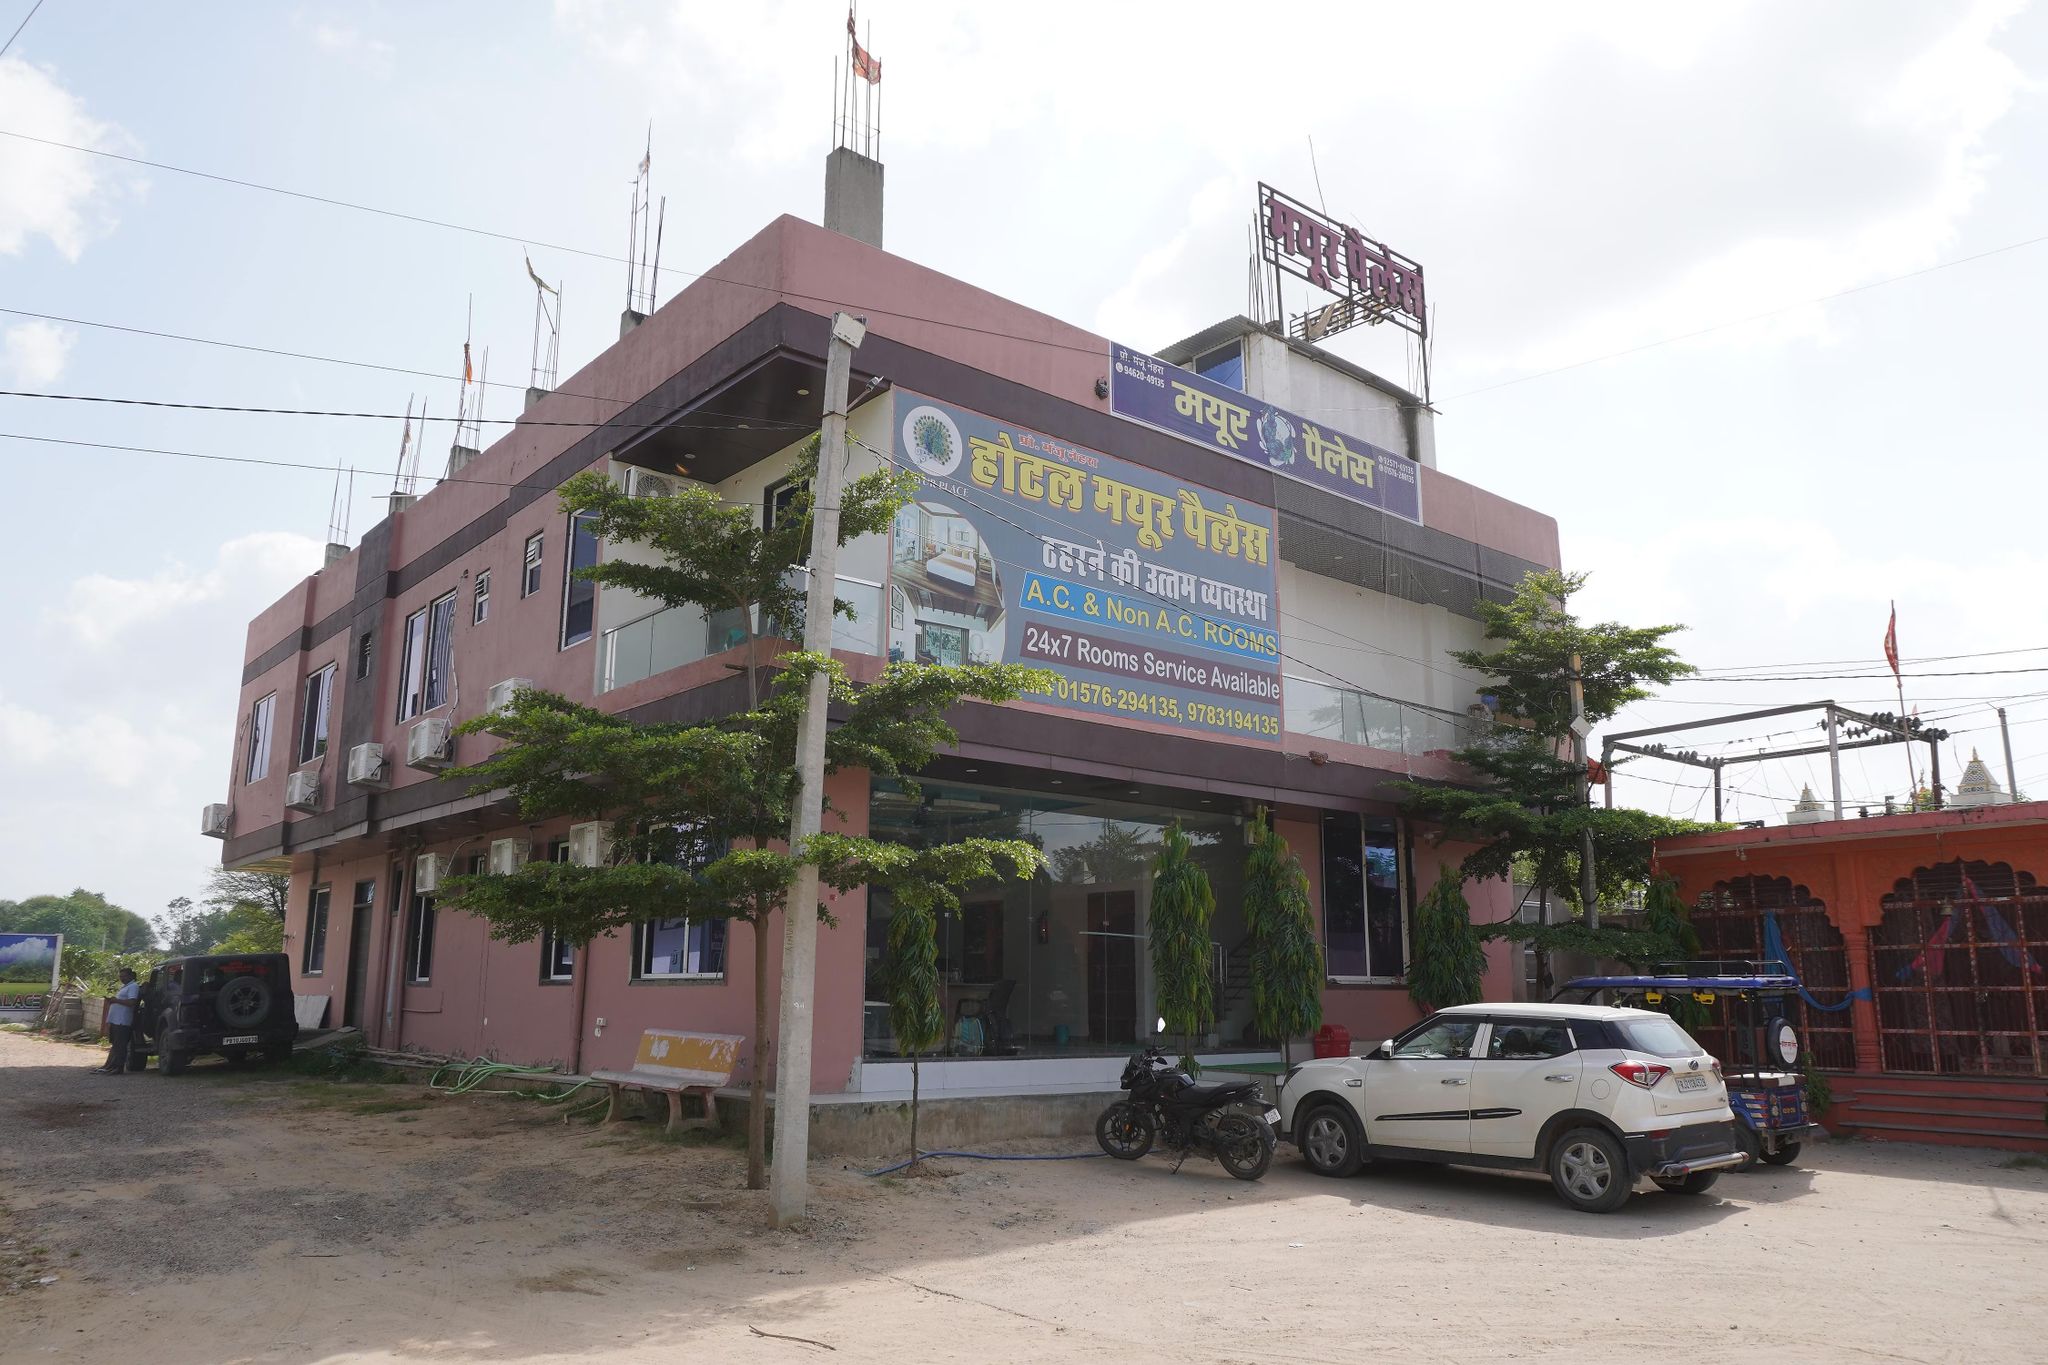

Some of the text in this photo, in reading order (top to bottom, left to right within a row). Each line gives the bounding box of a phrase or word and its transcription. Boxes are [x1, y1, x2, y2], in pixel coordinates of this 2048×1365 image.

[1265, 198, 1424, 320] मयूर पैलेस
[1123, 365, 1165, 388] 94620-49135
[1171, 380, 1375, 488] मयूर पैलेस
[968, 431, 1270, 566] होटल मयूर पैलेस
[1040, 535, 1268, 621] ठहरने की उत्तम व्यवस्था
[1027, 579, 1278, 656] A.C. & Non A.C. ROOMS
[1027, 627, 1280, 699] 24x7 Rooms Service Available
[1057, 678, 1279, 735] 01576-294135, 9783194135
[0, 993, 41, 1008] LACE
